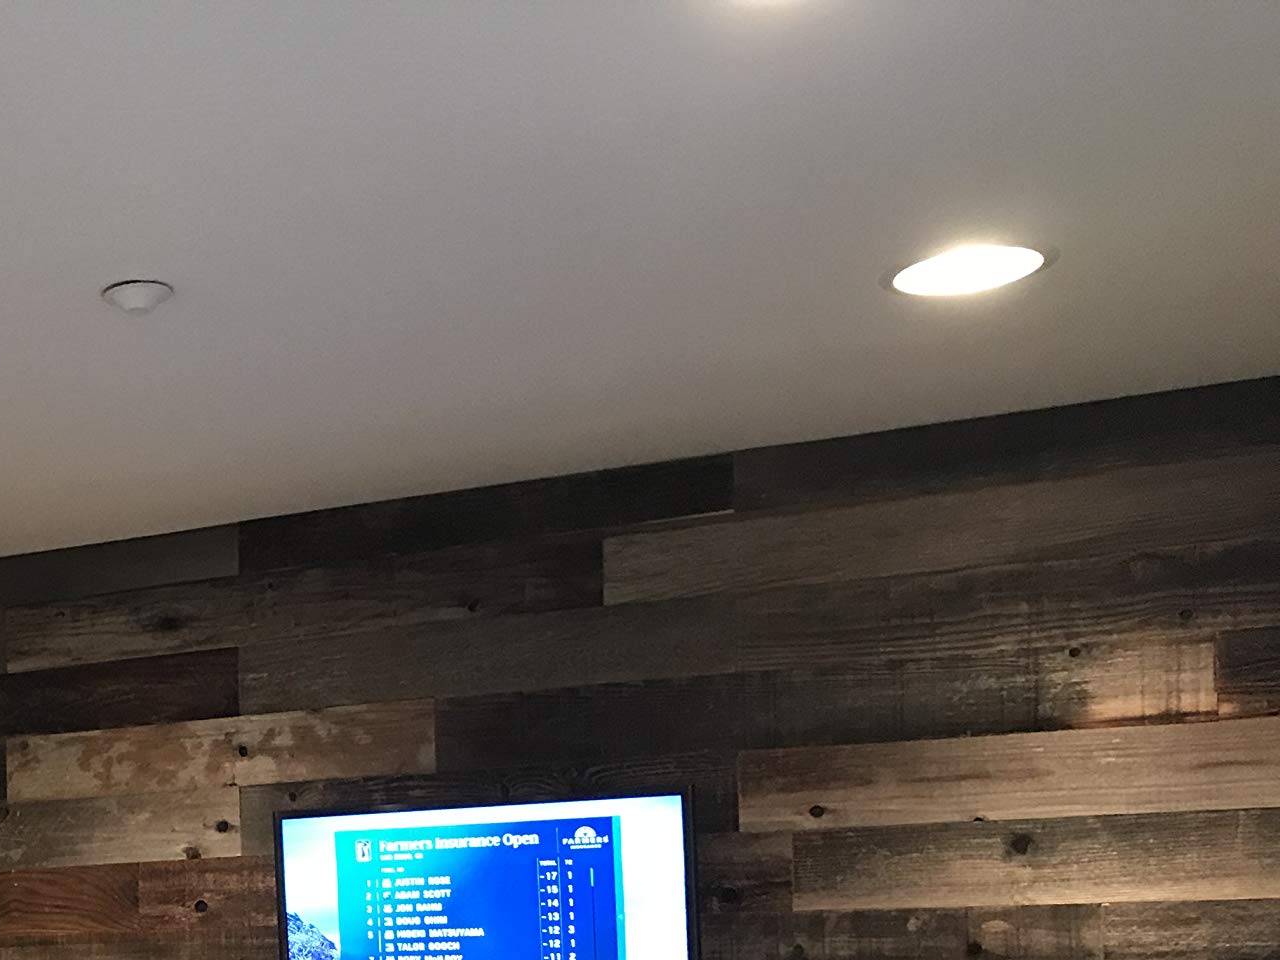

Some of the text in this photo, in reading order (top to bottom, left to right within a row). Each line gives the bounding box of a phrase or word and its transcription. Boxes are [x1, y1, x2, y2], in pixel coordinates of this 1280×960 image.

[380, 834, 539, 852] Farmers Insurance Open
[562, 835, 609, 845] FARMERS
[395, 878, 424, 886] JUSTIN
[428, 876, 450, 885] ROSE
[540, 872, 557, 880] -17
[395, 891, 420, 899] ADAM
[423, 889, 451, 898] SCOTT
[540, 885, 558, 893] -15
[396, 904, 413, 912] JON
[541, 899, 559, 907] -14
[542, 912, 559, 921] -13
[429, 928, 484, 937] MATSUYAMA
[542, 926, 560, 934] -12
[397, 943, 425, 951] TALOR
[543, 939, 560, 948] -12
[544, 953, 560, 960] -11
